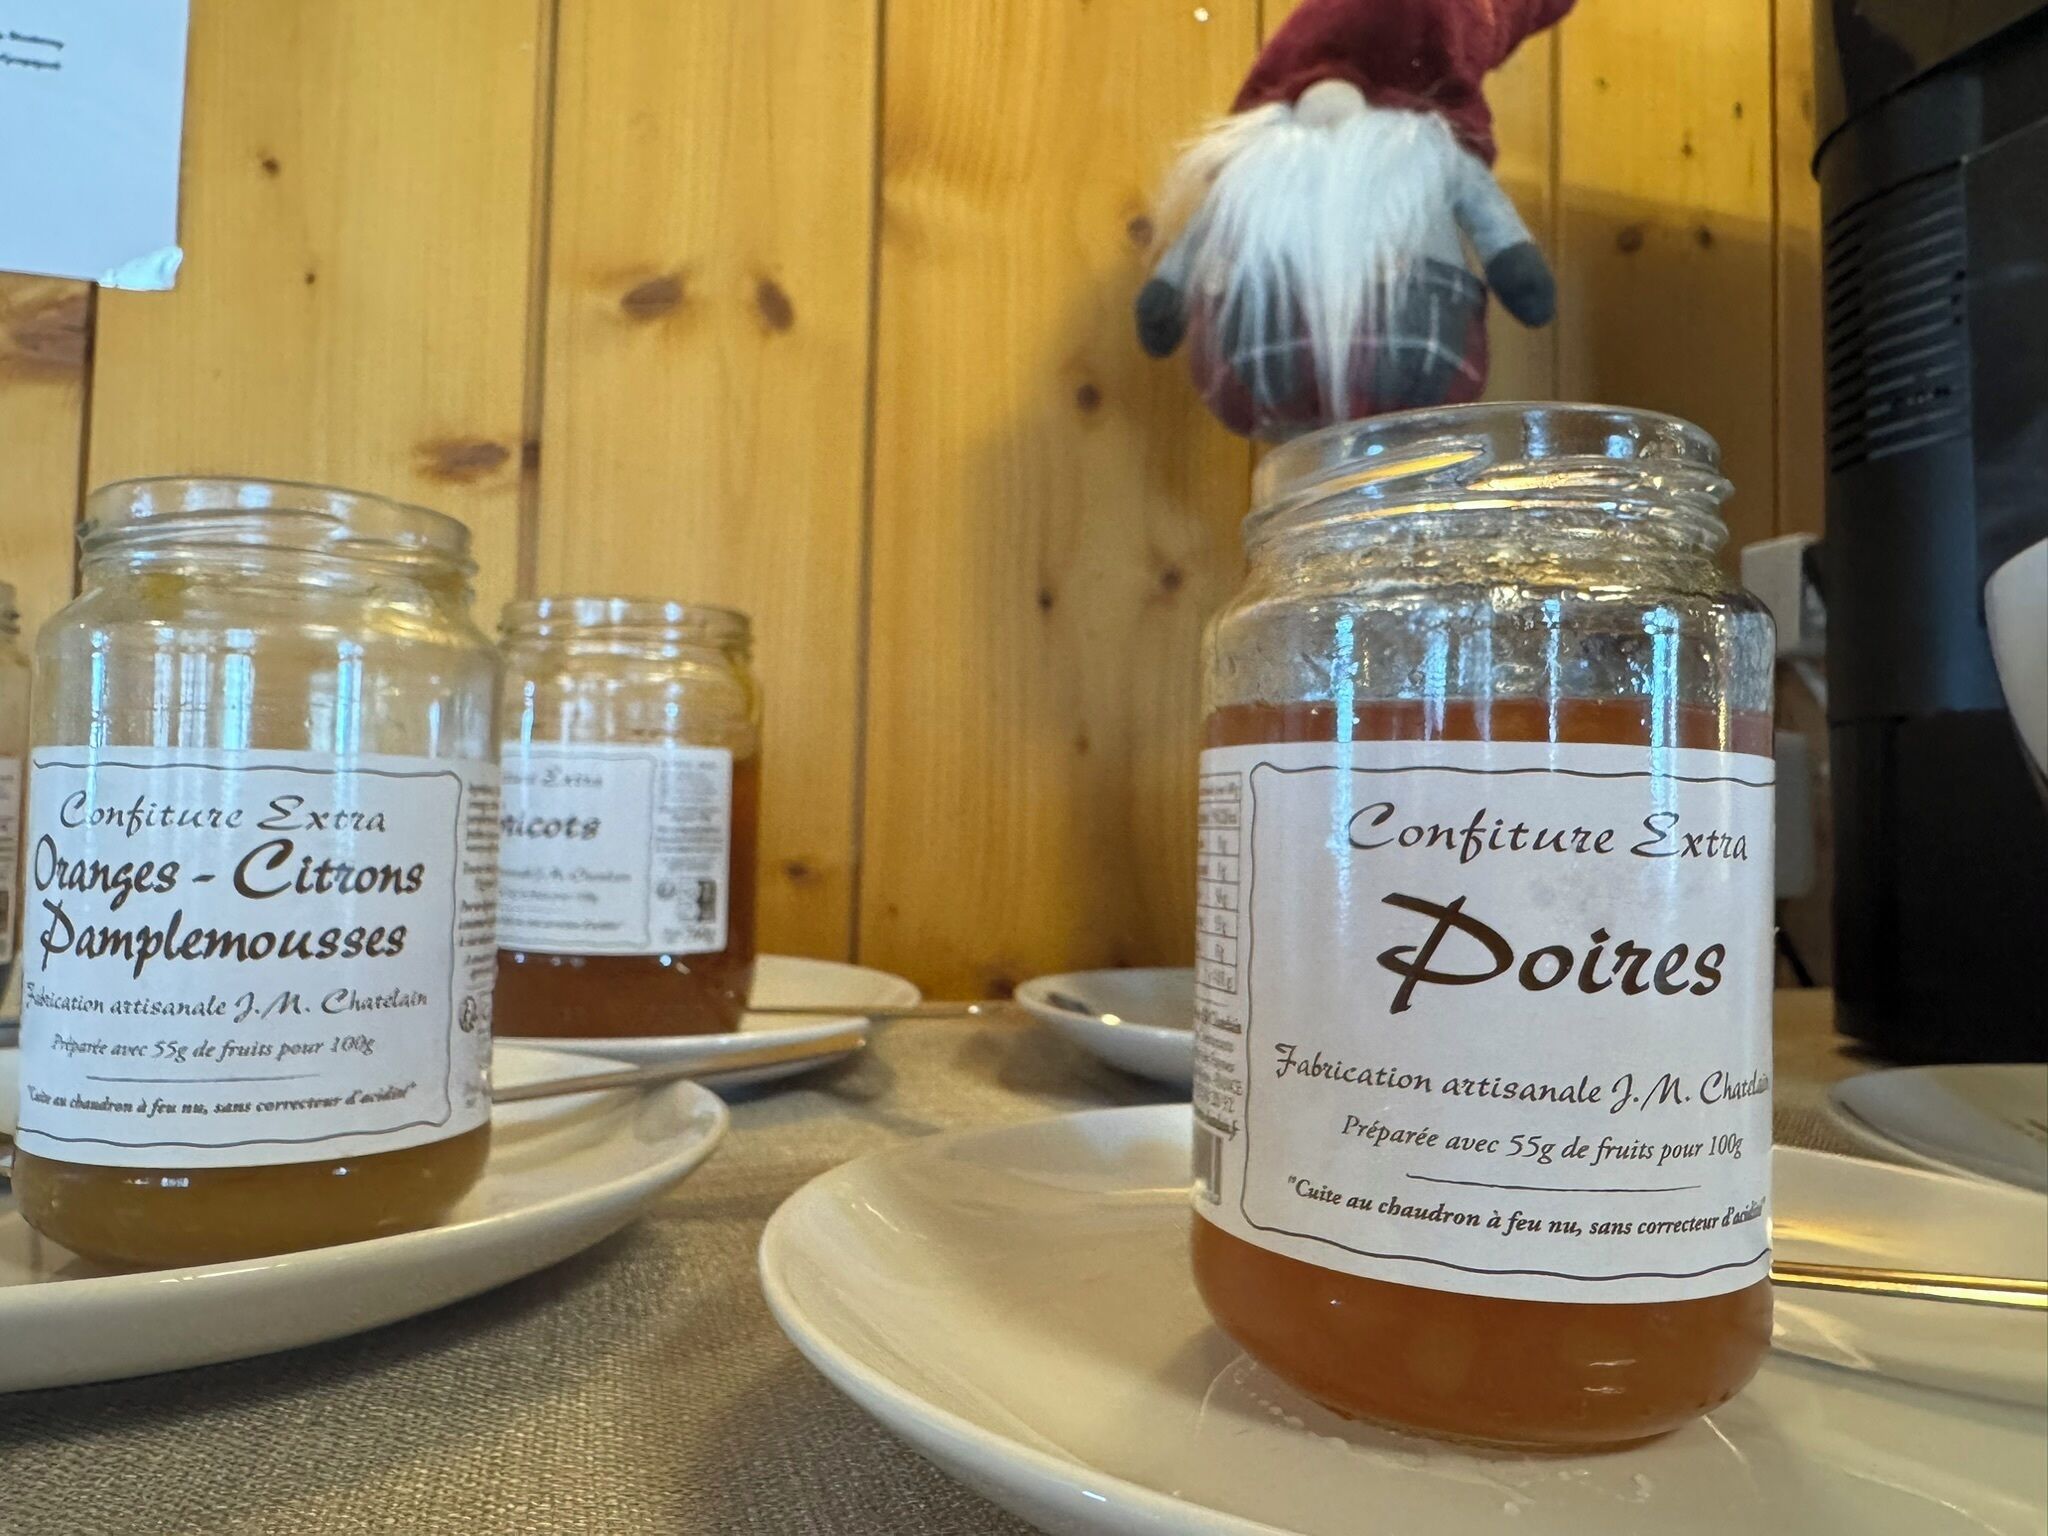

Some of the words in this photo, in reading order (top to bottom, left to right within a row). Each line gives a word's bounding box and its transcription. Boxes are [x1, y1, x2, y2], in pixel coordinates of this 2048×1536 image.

[60, 790, 243, 836] Confiture
[257, 794, 386, 833] Extra
[1346, 801, 1614, 864] Confiture
[1630, 811, 1748, 862] Extra
[33, 833, 180, 911] Oranges
[233, 838, 425, 899] Citrons
[40, 898, 407, 979] Pamplemousses
[1376, 892, 1726, 1015] Poires
[109, 995, 227, 1016] artisanale
[321, 987, 428, 1015] Chatelain
[110, 1043, 148, 1057] avec
[151, 1040, 189, 1063] 55g
[192, 1039, 217, 1058] de
[215, 1039, 273, 1063] fruits
[275, 1041, 325, 1062] pour
[1275, 1042, 1431, 1094] Fabrication
[1441, 1075, 1602, 1104] artisanale
[147, 1097, 176, 1118] feu
[213, 1101, 251, 1114] sans
[1341, 1114, 1439, 1147] Préparée
[1444, 1134, 1500, 1154] avec
[1505, 1134, 1556, 1164] 55g
[1560, 1135, 1590, 1159] de
[1589, 1136, 1655, 1167] fruits
[1656, 1142, 1704, 1167] pour
[1708, 1133, 1744, 1160] 100g
[1346, 1192, 1373, 1213] au
[1378, 1196, 1481, 1228] chaudron
[1486, 1210, 1501, 1230] à
[1501, 1210, 1542, 1237] feu
[1548, 1214, 1583, 1237] nu,
[1589, 1220, 1632, 1236] sans
[1637, 1217, 1720, 1235] correcteur
